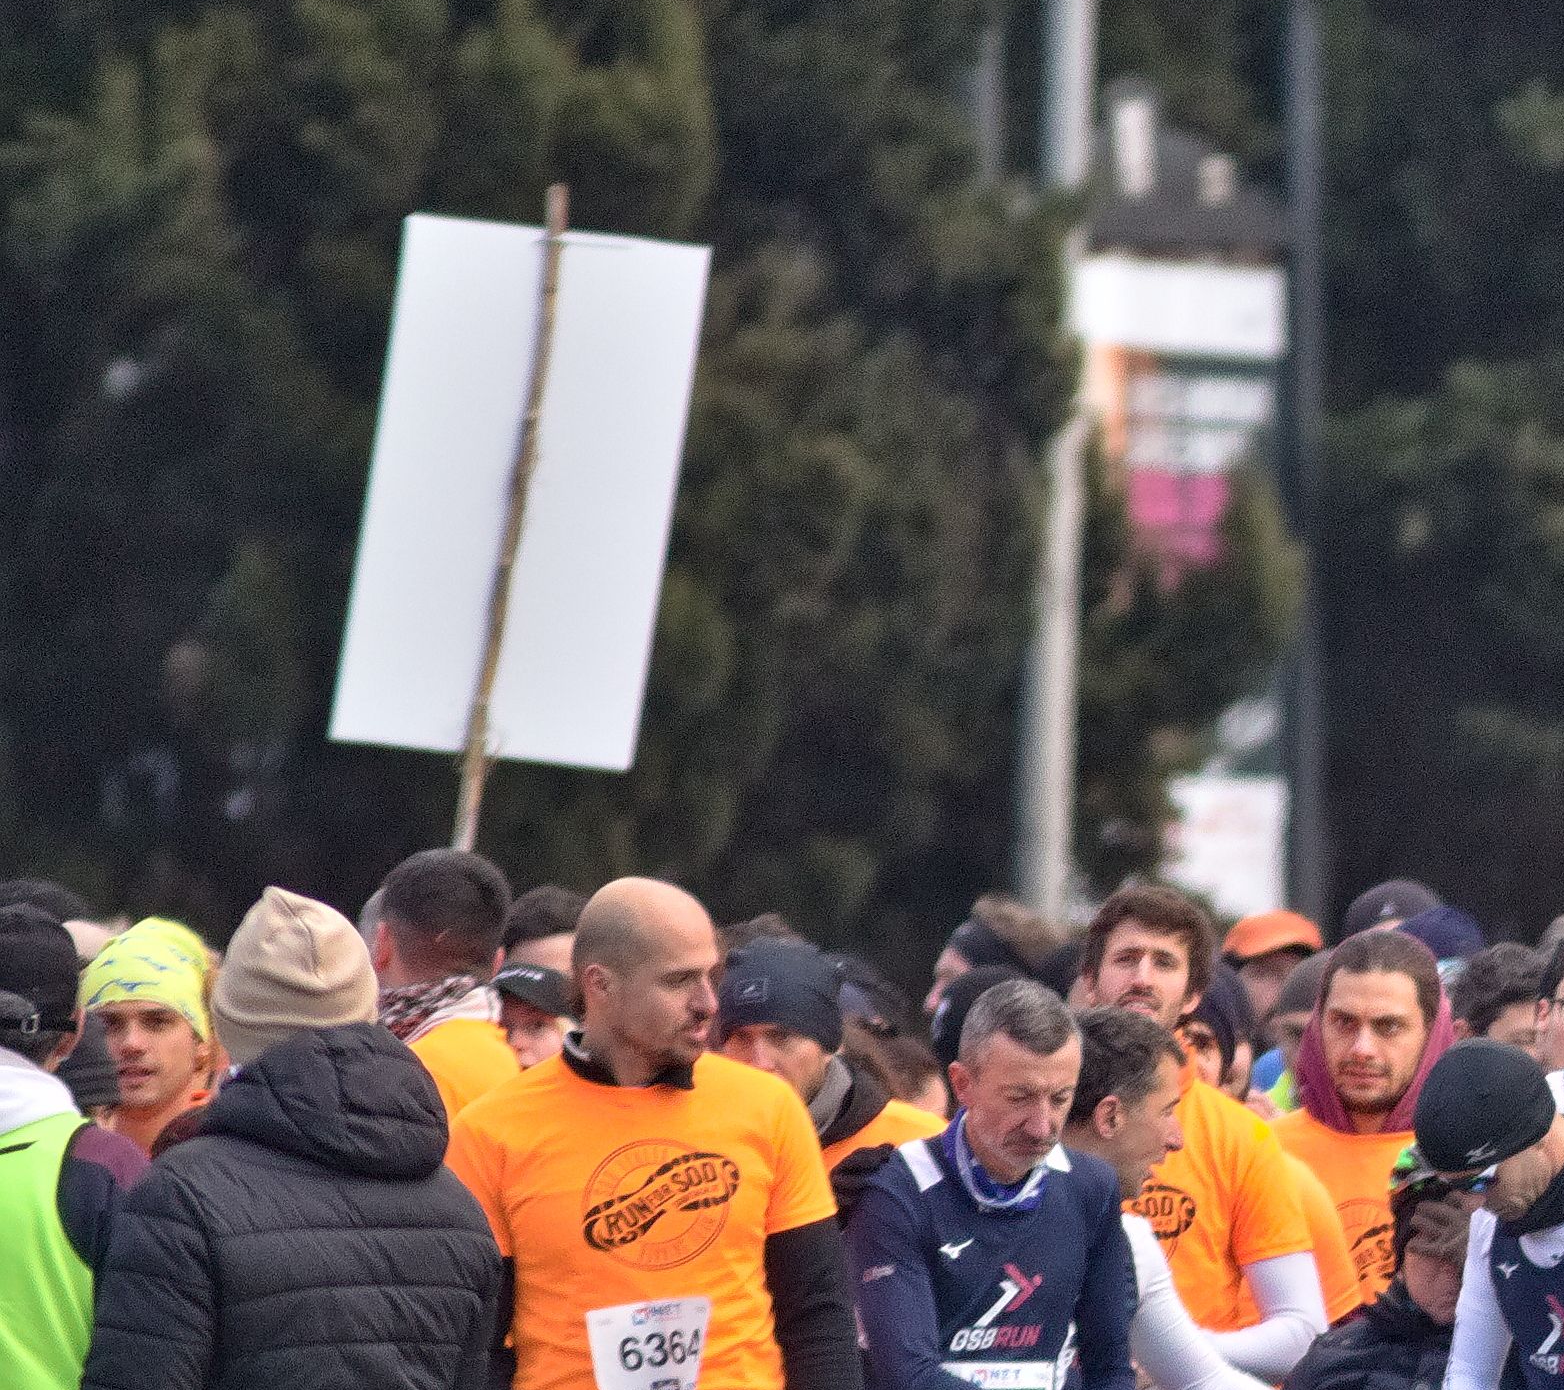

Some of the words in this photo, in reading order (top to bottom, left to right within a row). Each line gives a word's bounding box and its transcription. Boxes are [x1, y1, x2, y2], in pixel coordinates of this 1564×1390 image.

[605, 1199, 655, 1237] RUN
[671, 1161, 718, 1194] SOD
[619, 1327, 701, 1372] 6364
